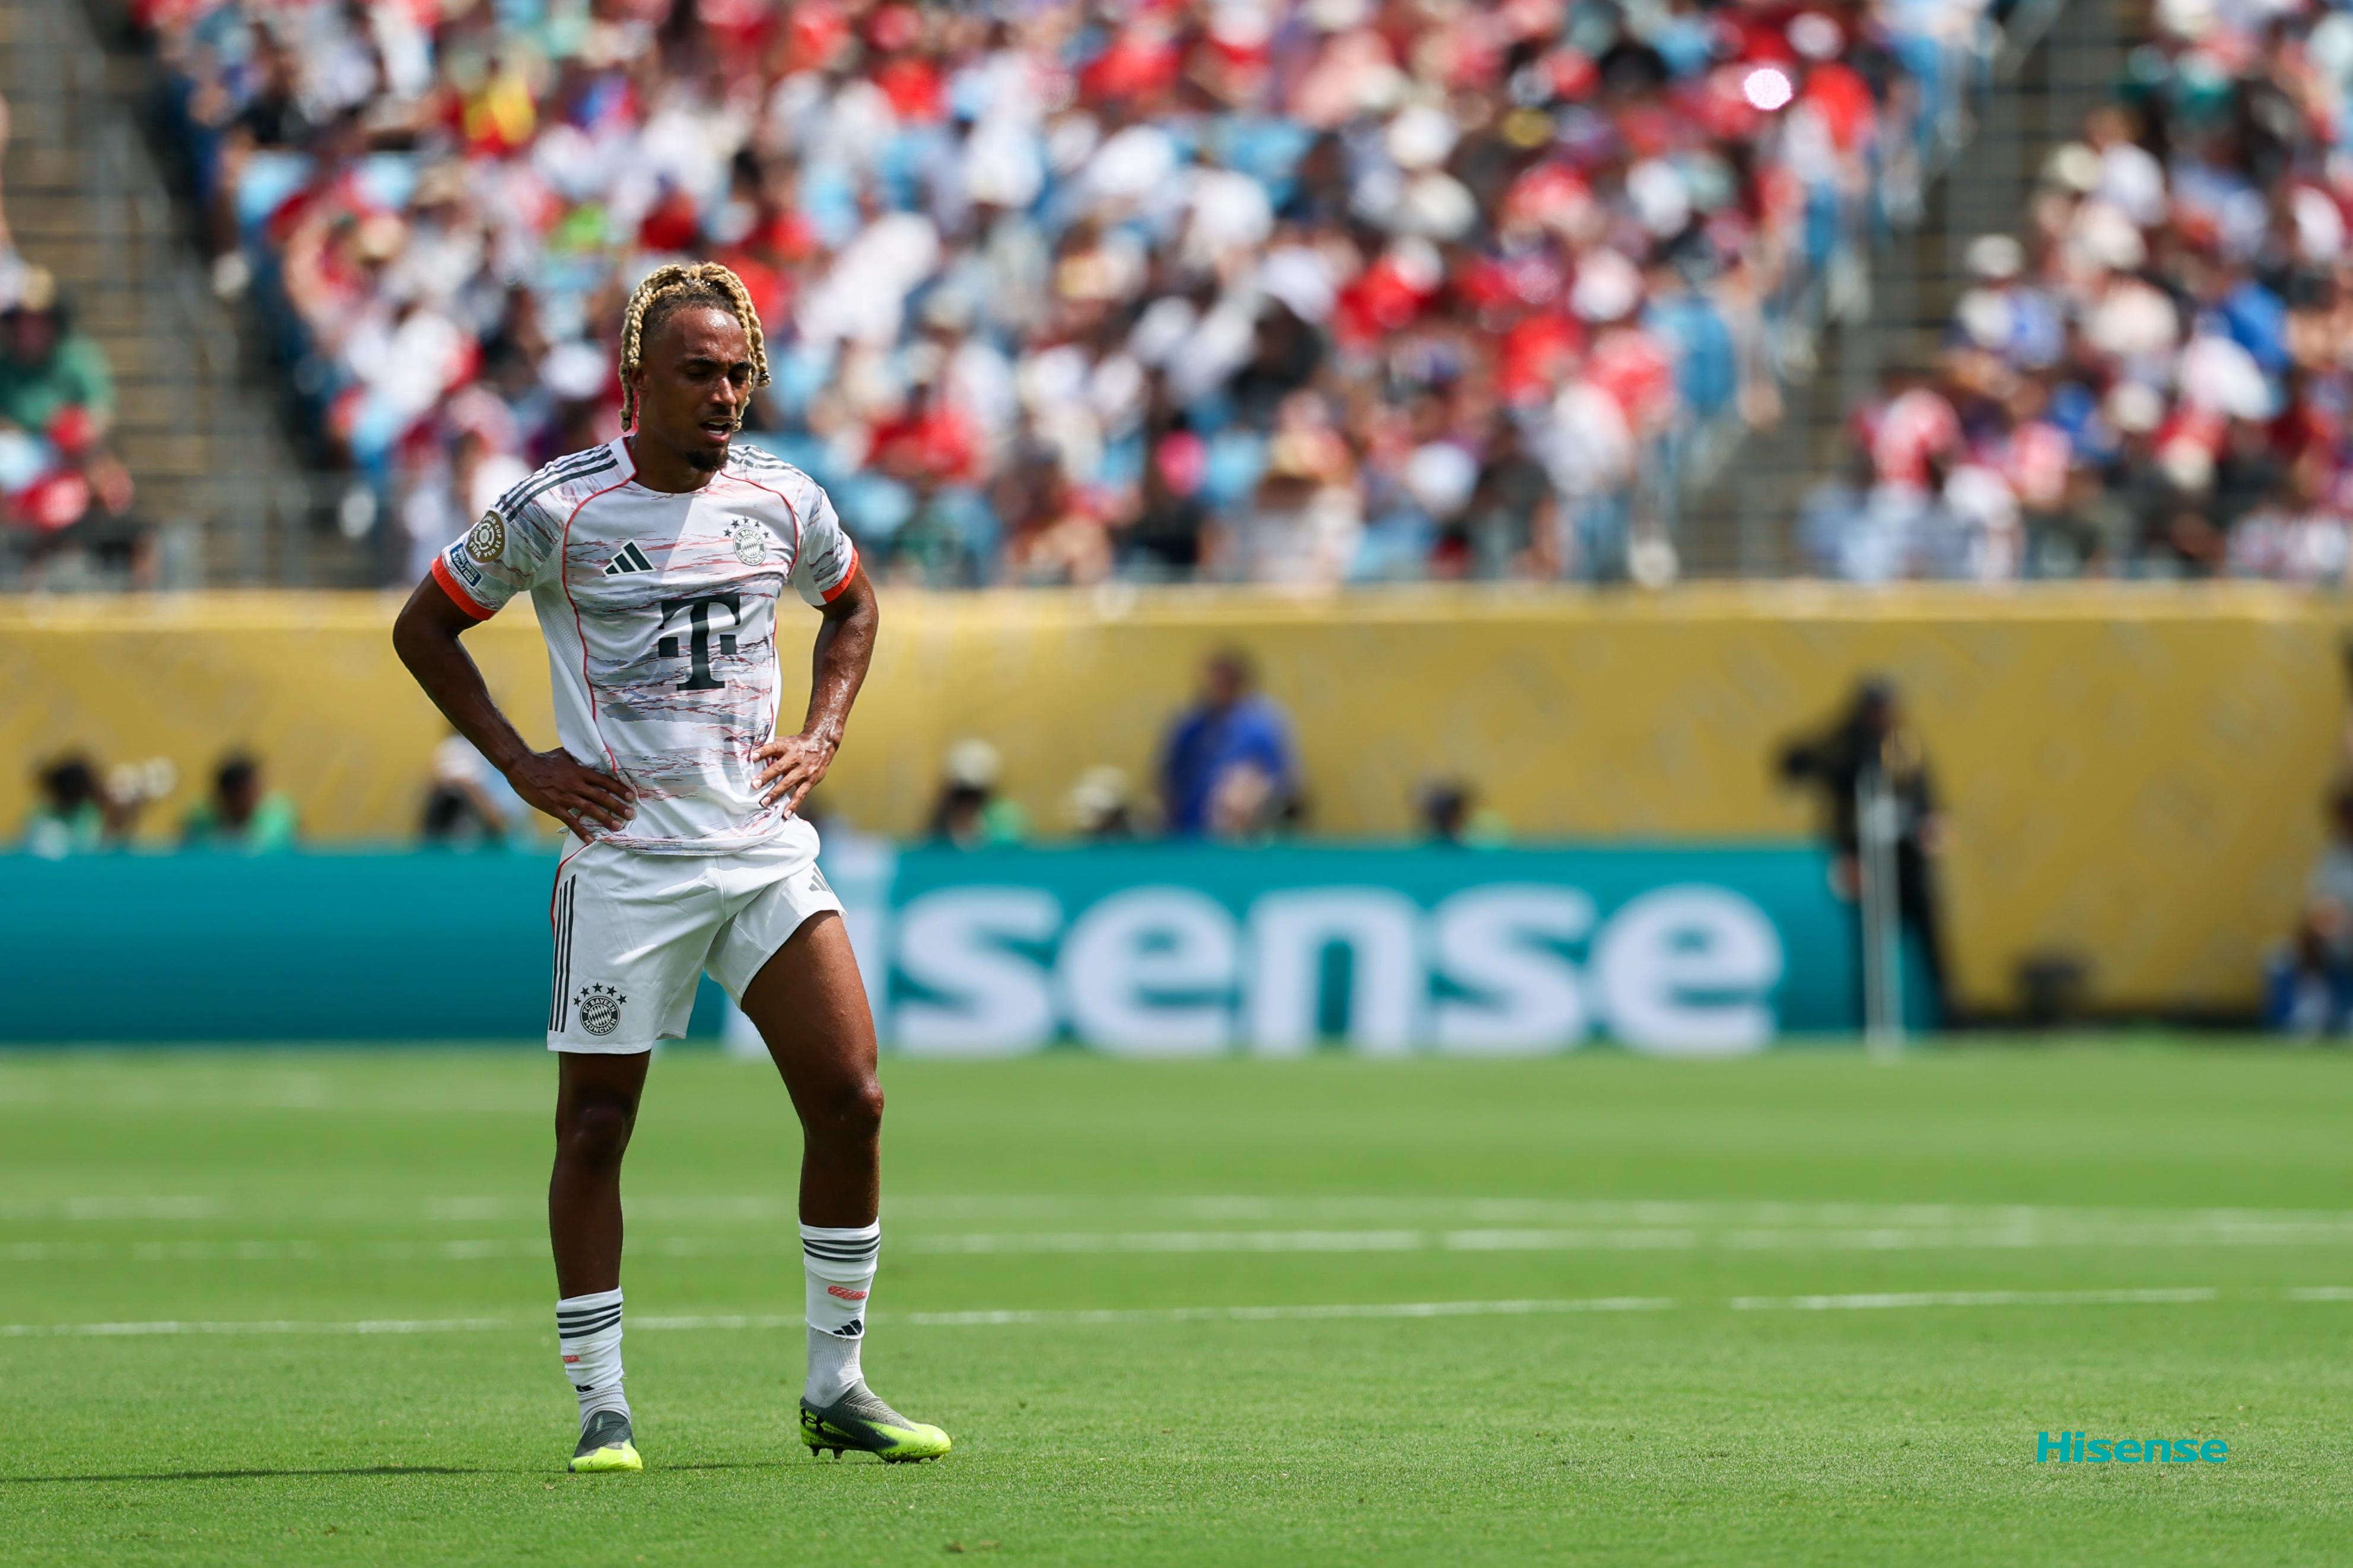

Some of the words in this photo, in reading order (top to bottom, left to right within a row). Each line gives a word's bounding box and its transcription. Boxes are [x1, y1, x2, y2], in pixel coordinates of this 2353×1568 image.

[469, 541, 482, 558] FIFA
[484, 548, 496, 557] USA
[658, 593, 740, 691] T
[583, 1004, 590, 1013] FC
[590, 998, 616, 1012] BAYERN
